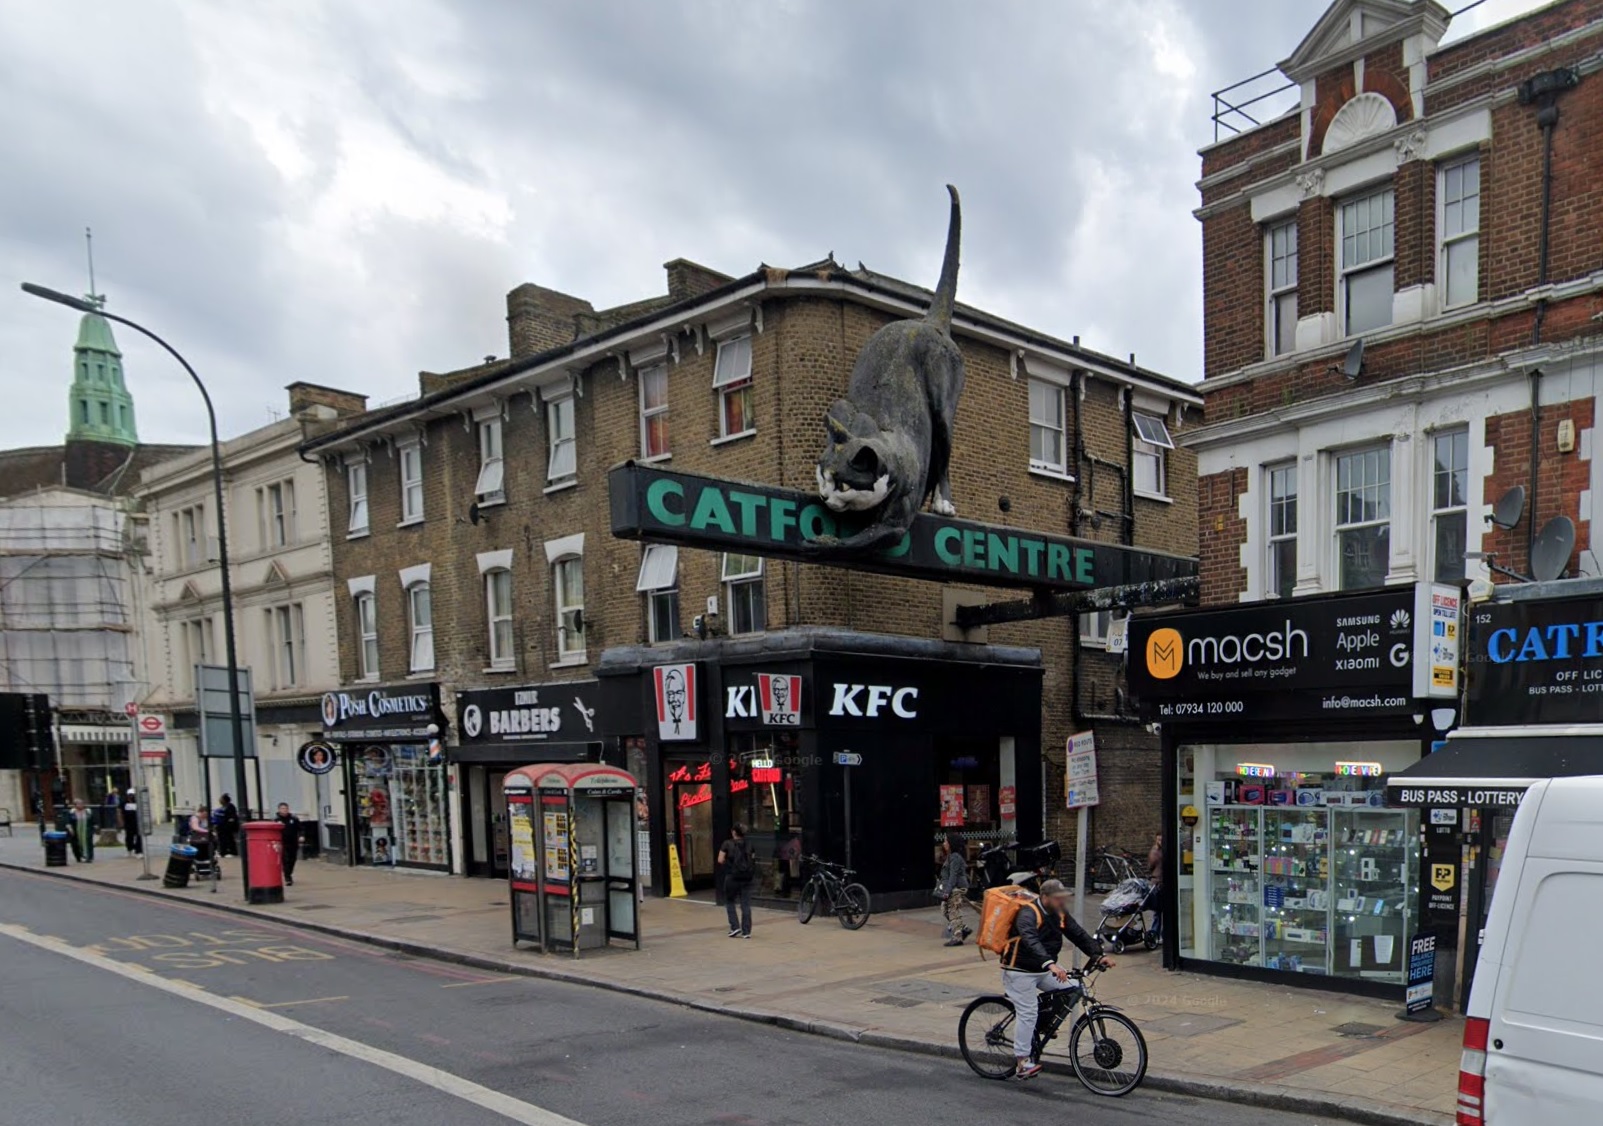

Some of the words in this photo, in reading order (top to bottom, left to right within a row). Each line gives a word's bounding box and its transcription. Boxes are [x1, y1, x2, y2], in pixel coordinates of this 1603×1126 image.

[646, 478, 911, 558] CATFO
[934, 526, 1096, 585] CENTRE
[1336, 614, 1380, 627] SAMSUNG
[1475, 614, 1491, 624] 152
[1188, 619, 1308, 666] macsh
[1336, 629, 1380, 653] Apple
[1389, 643, 1410, 667] G
[1335, 657, 1380, 671] xiaomi
[1197, 671, 1209, 680] We
[1210, 671, 1223, 681] buy
[1225, 668, 1239, 678] and
[1241, 667, 1252, 678] sell
[1254, 669, 1268, 678] any
[1269, 666, 1297, 678] gadget
[1556, 671, 1579, 681] OFF
[1583, 669, 1603, 680] LIC
[1528, 686, 1547, 695] BUS
[1549, 685, 1573, 694] PASS
[339, 693, 367, 719] POSH
[368, 690, 427, 718] COSMETICS
[829, 683, 918, 718] KFC
[1159, 704, 1173, 715] Tel:
[1175, 703, 1203, 714] 07934
[1207, 702, 1222, 713] 120
[1225, 701, 1243, 712] 000
[1322, 694, 1406, 709] info@macsh.com
[490, 707, 561, 734] BARBERS
[769, 713, 795, 724] KFC
[752, 759, 773, 768] HELLO
[1401, 790, 1424, 802] BUS
[1427, 790, 1458, 803] PASS
[1468, 791, 1524, 804] LOTTERY
[1412, 936, 1436, 955] FREE
[1411, 951, 1434, 962] BALANCE
[1410, 964, 1433, 981] HERE
